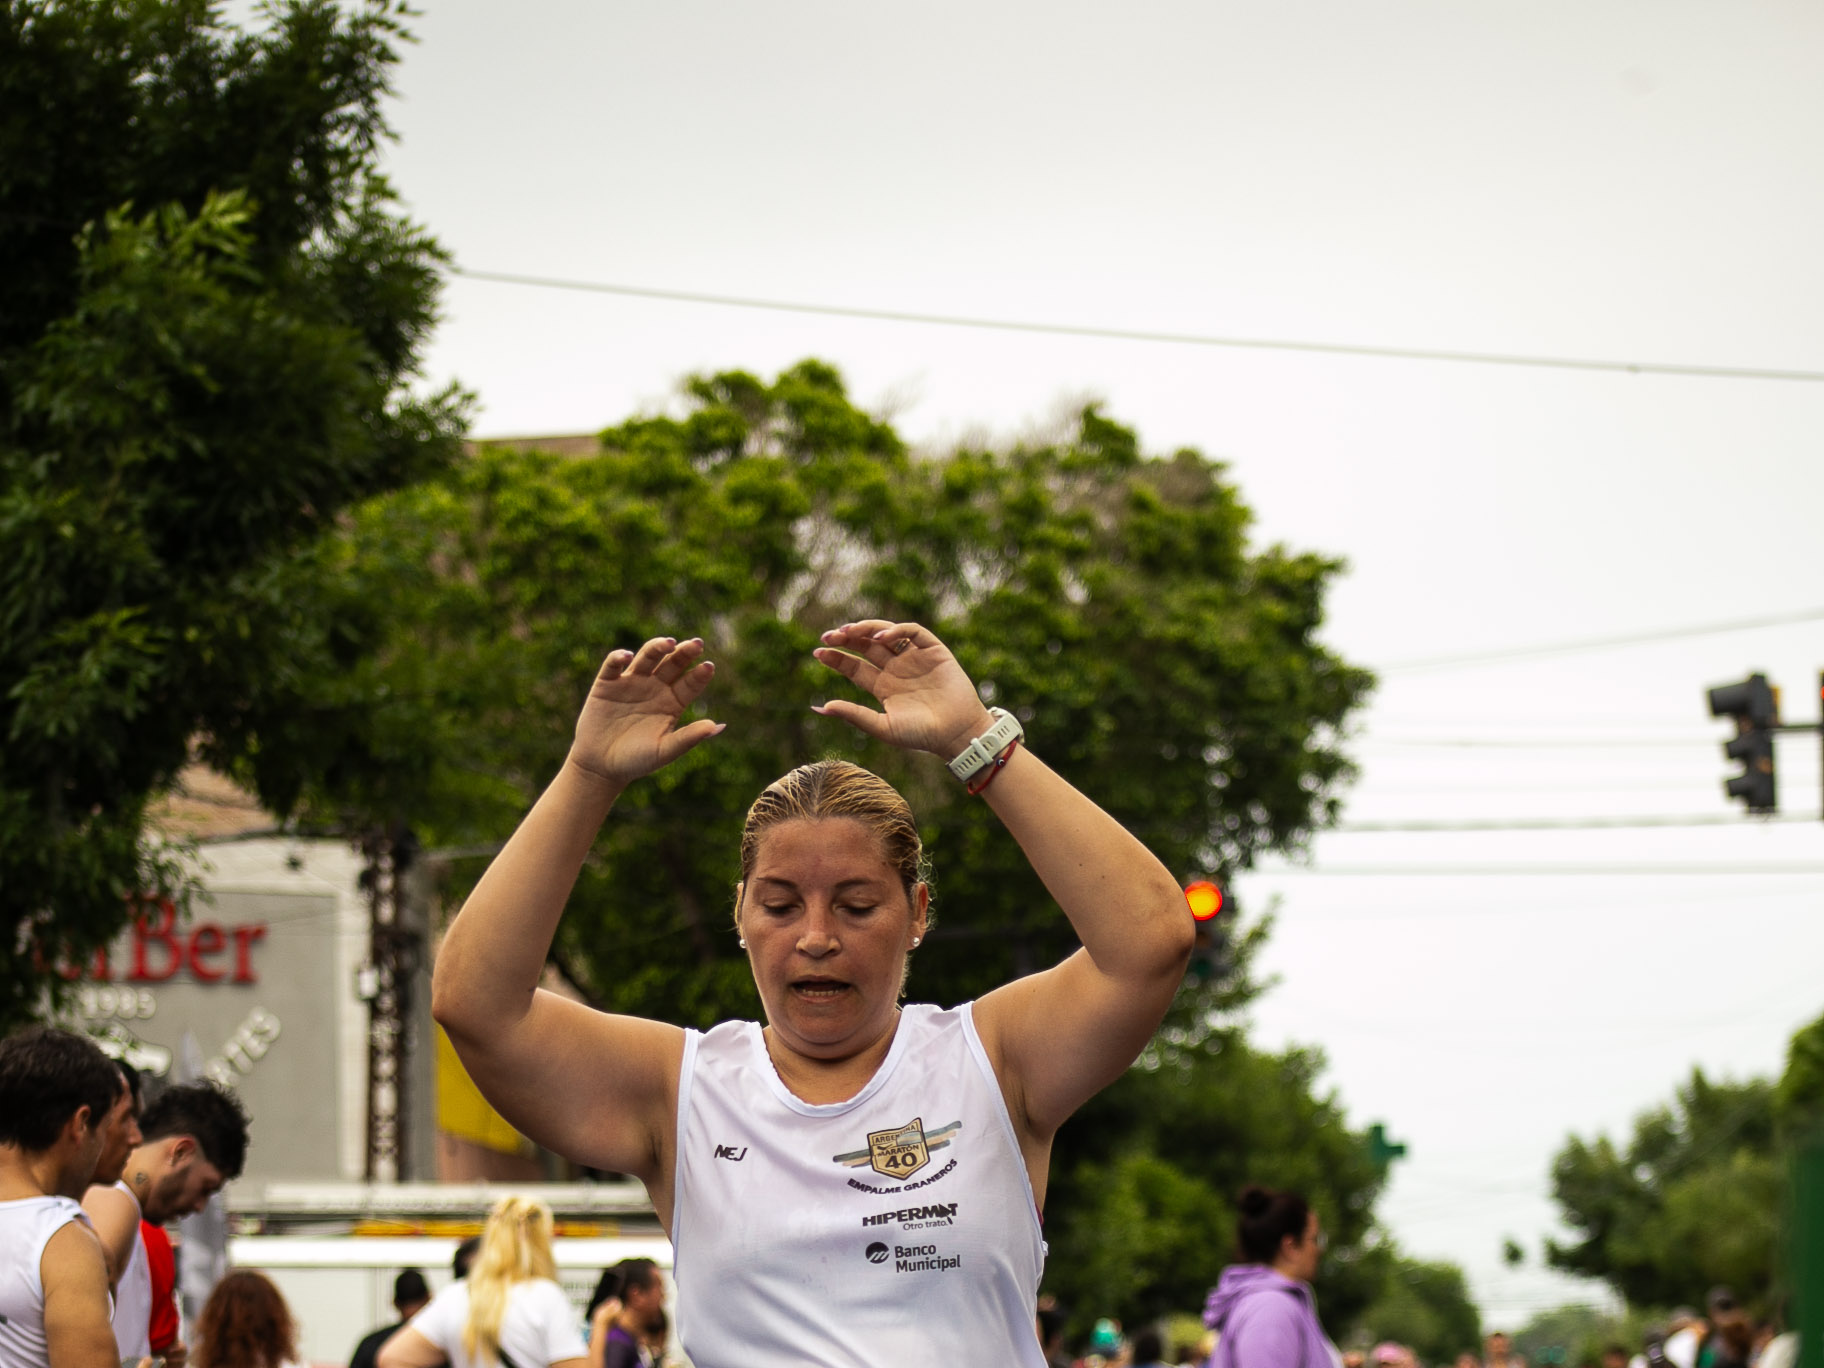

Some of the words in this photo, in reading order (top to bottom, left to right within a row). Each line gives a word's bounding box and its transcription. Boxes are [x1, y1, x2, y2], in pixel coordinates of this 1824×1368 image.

[713, 1144, 748, 1162] NEJ
[885, 1152, 917, 1169] 40
[847, 1178, 902, 1195] EMPALME
[904, 1159, 958, 1191] GRANEROS
[903, 1222, 923, 1231] Otro
[894, 1244, 937, 1259] Banco
[895, 1254, 961, 1273] Municipal
